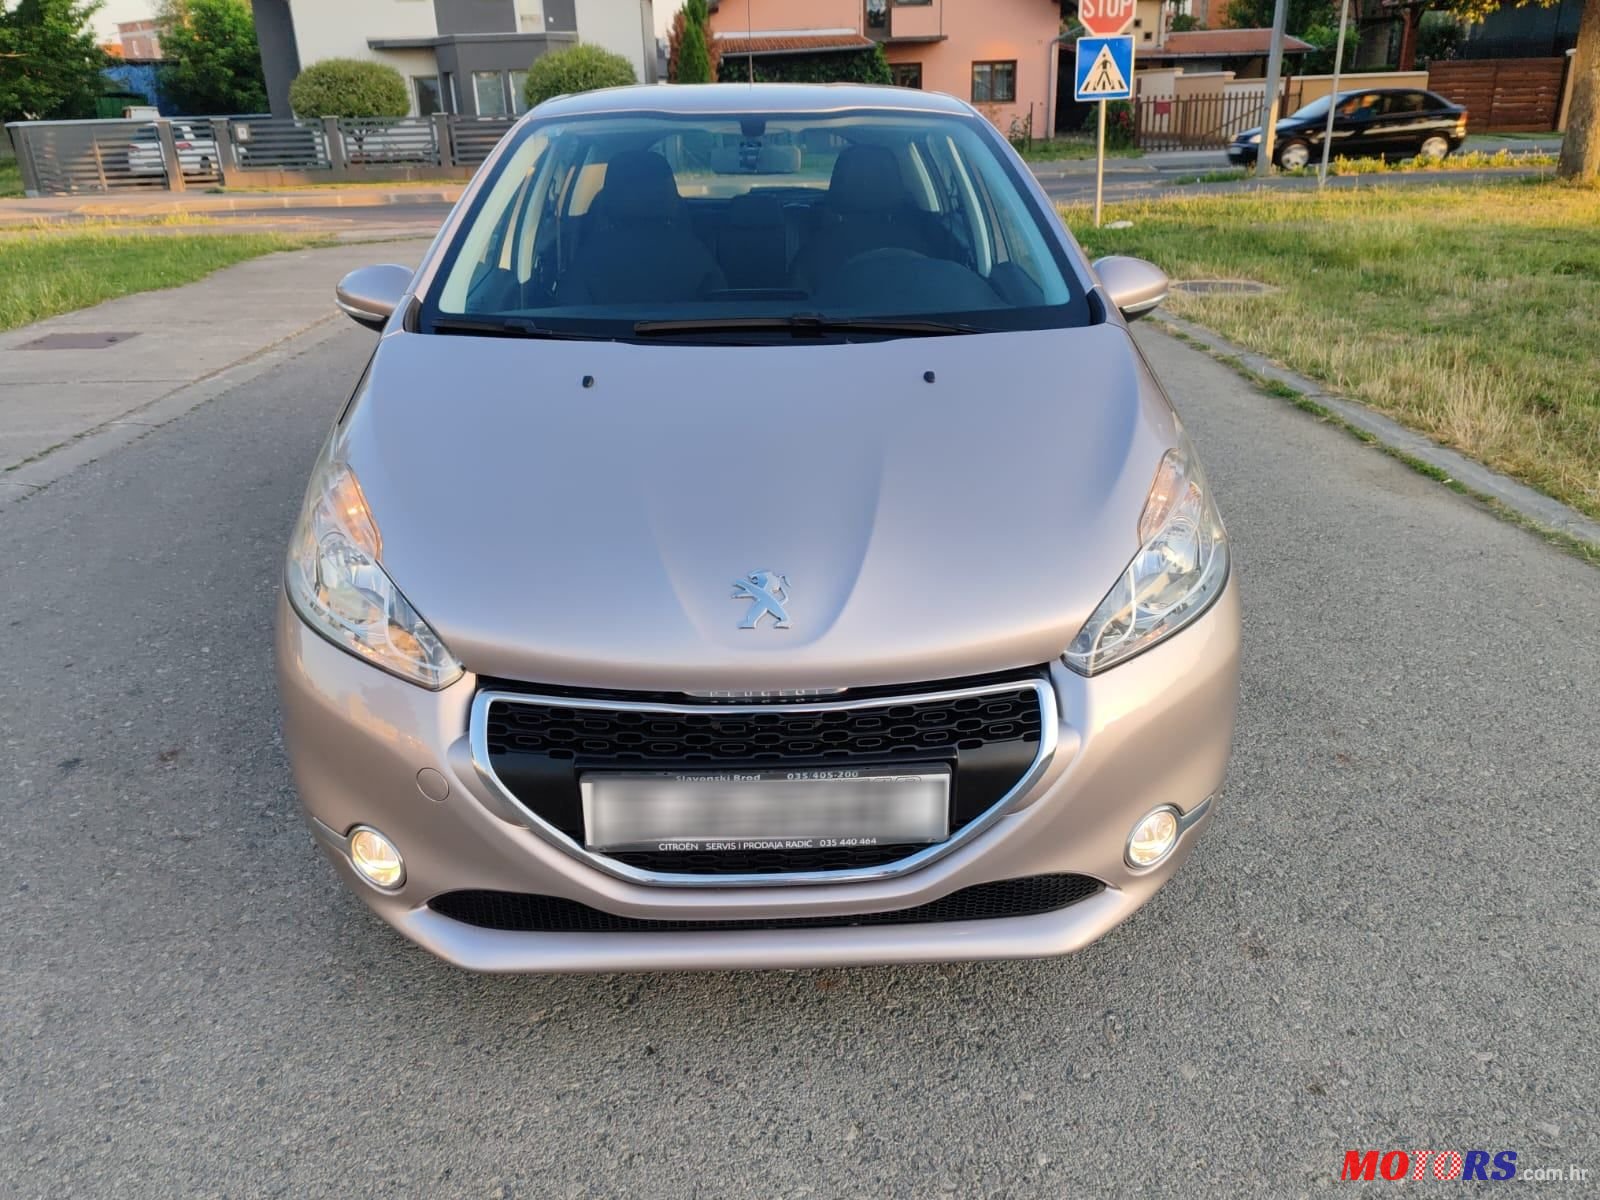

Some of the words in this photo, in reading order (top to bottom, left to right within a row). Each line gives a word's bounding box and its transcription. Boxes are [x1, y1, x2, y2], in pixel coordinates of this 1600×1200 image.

[1082, 0, 1132, 17] STOP
[675, 774, 731, 782] Slavonski
[733, 774, 761, 782] Brod
[705, 841, 737, 851] SERVIS
[743, 841, 784, 851] PRODAJA
[820, 838, 837, 848] 035
[839, 837, 857, 847] 440
